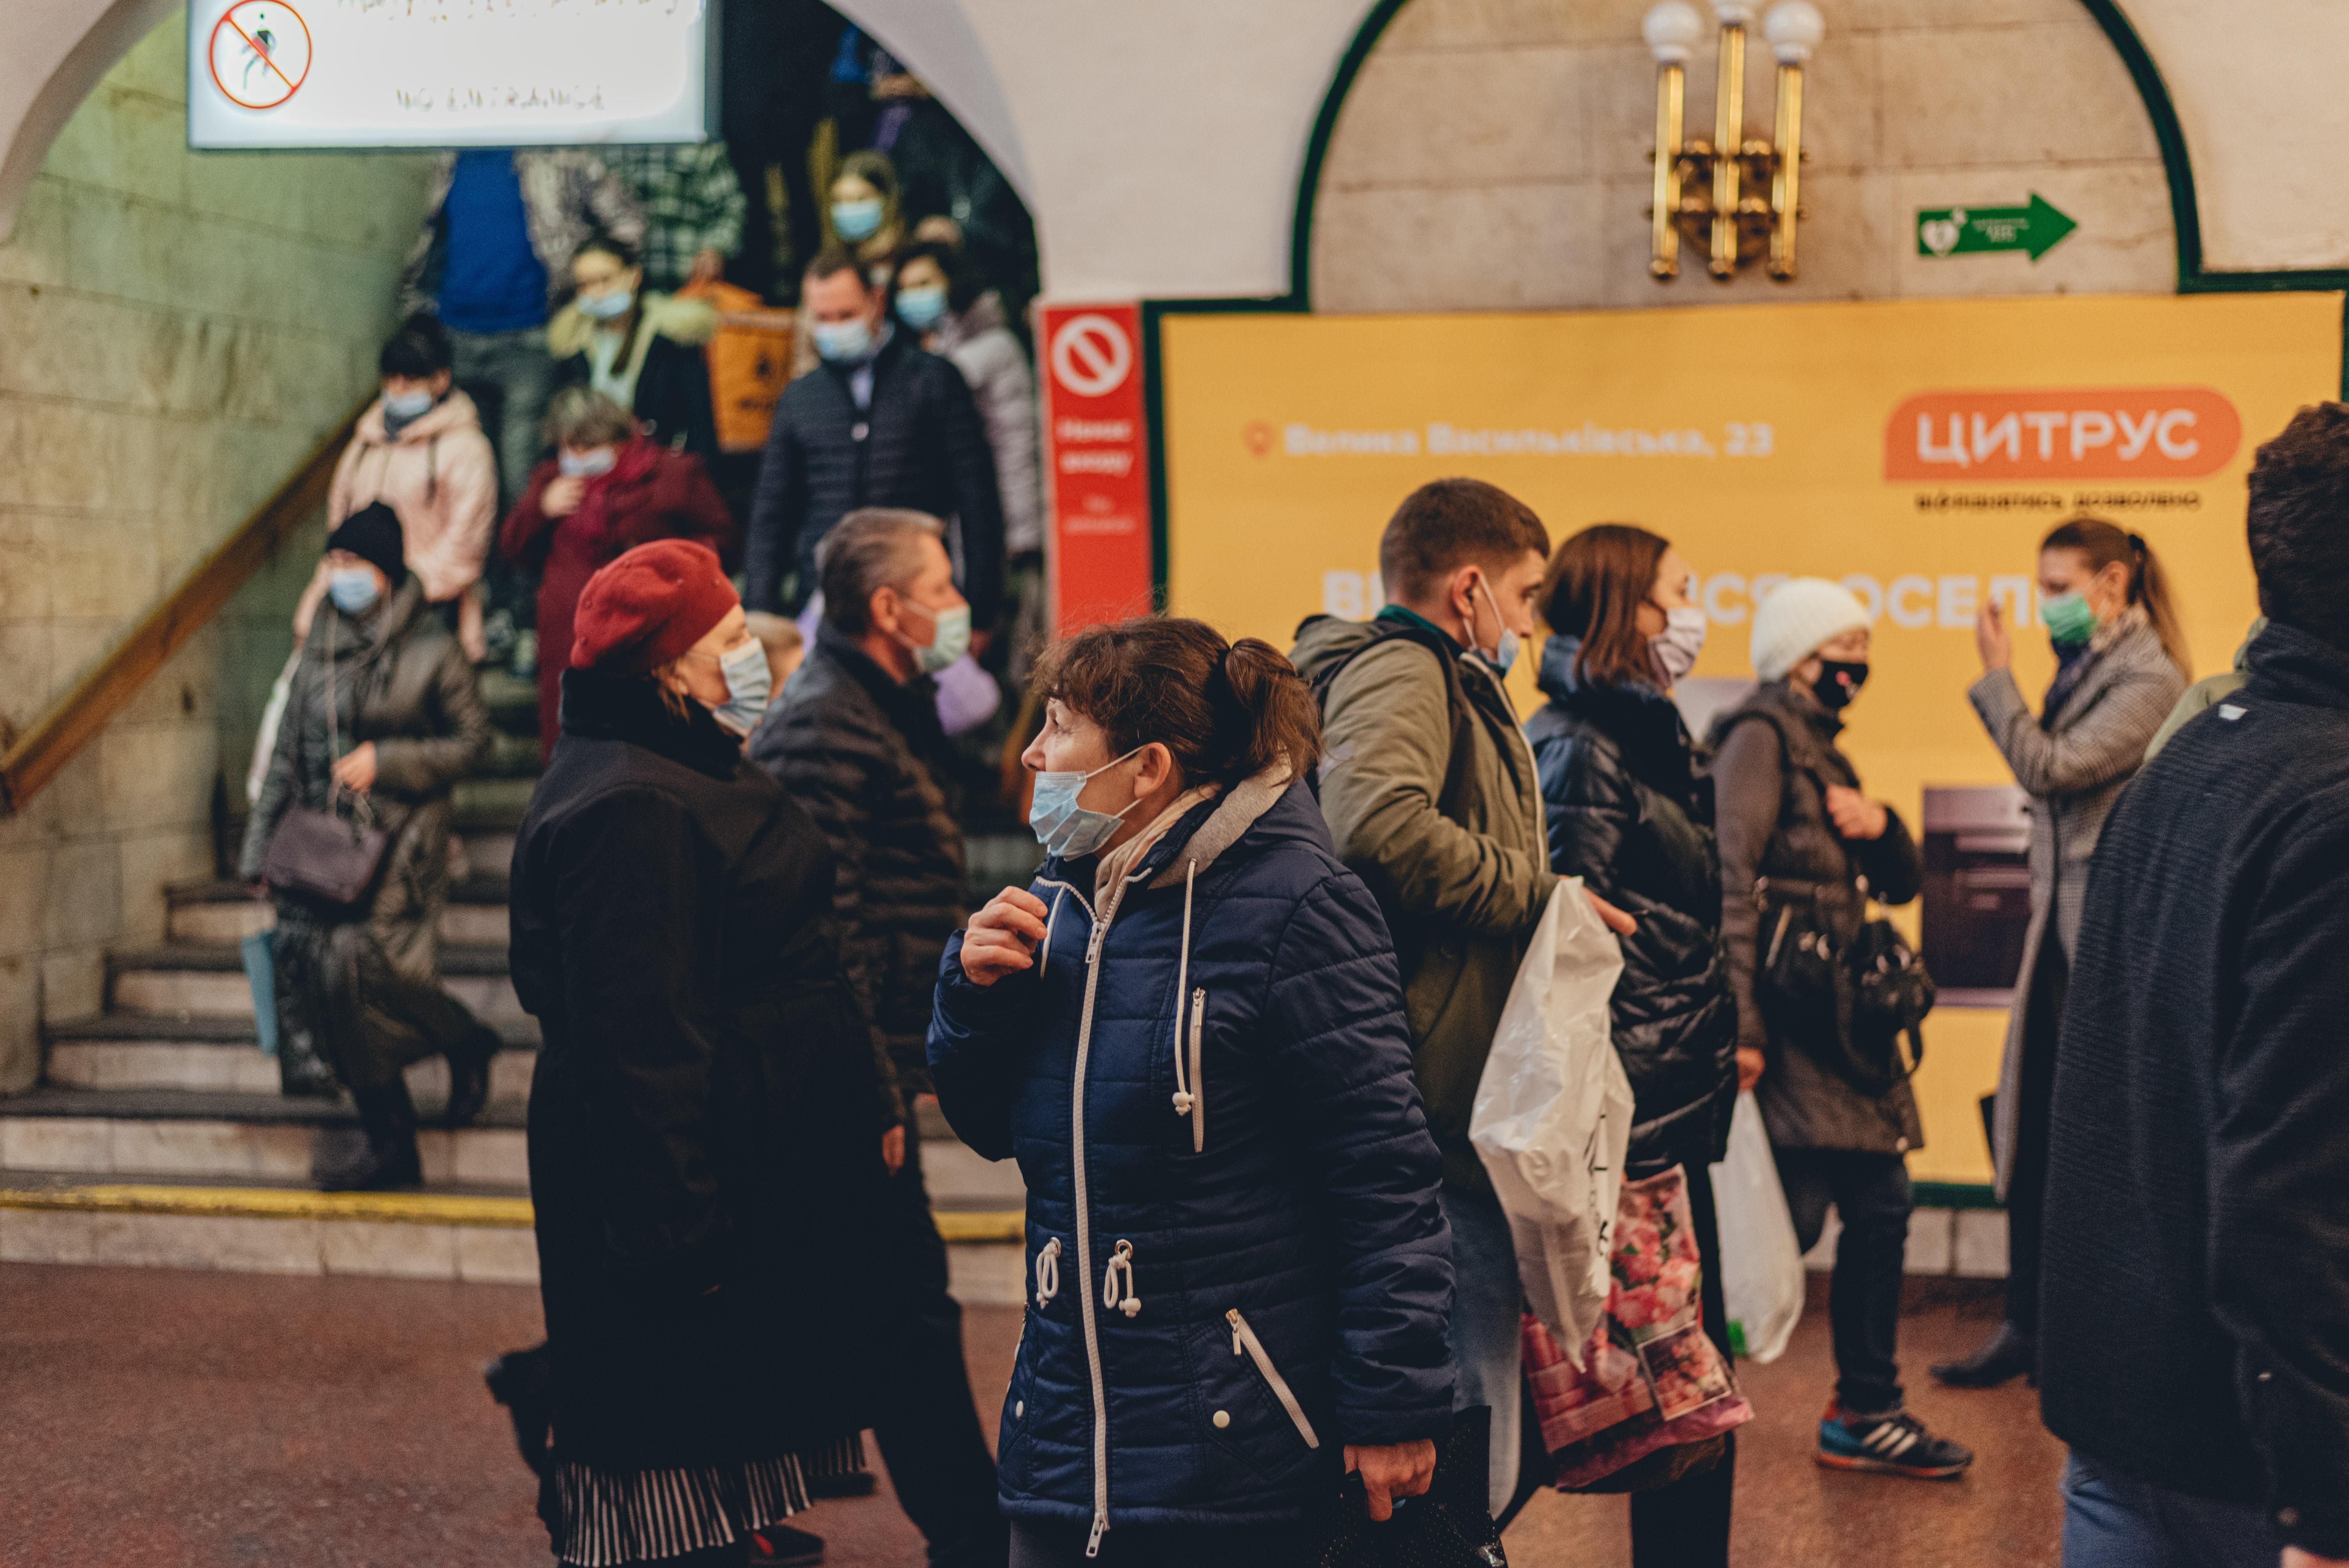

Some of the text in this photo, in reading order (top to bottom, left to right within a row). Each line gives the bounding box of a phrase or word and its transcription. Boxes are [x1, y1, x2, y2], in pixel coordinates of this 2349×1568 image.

[1285, 422, 1417, 455] Велика
[1723, 422, 1773, 456] 23
[1916, 408, 2199, 468] ЦИТРУС
